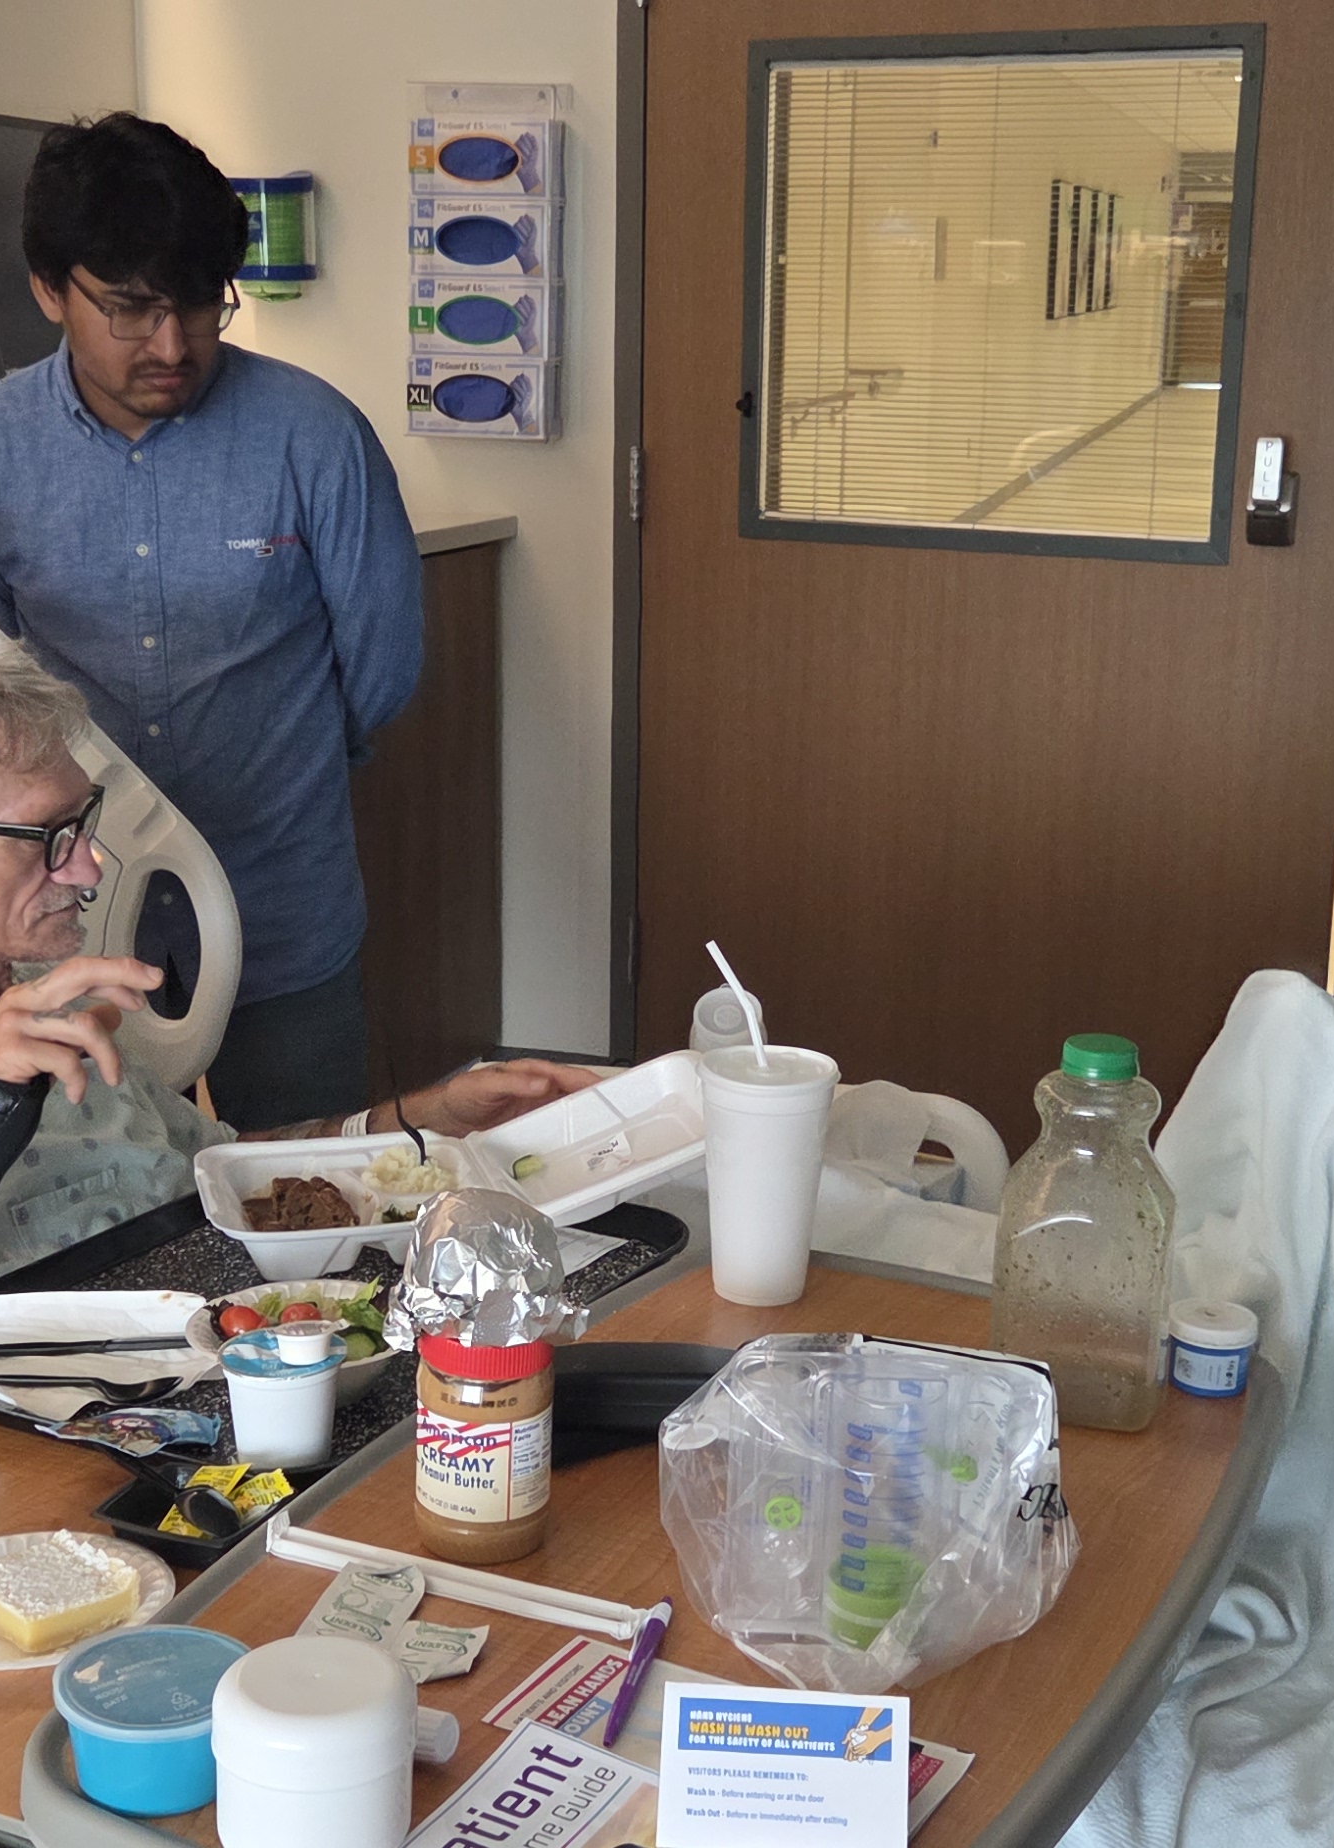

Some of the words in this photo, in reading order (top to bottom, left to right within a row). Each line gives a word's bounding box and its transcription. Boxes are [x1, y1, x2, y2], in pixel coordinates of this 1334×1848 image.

[415, 148, 427, 166] S
[413, 229, 429, 247] M
[417, 308, 428, 326] L
[409, 387, 429, 404] XL
[1262, 441, 1273, 497] PULL
[226, 537, 266, 550] TOMMY
[422, 1417, 497, 1447] American
[422, 1444, 495, 1474] CREAMY
[454, 1472, 495, 1489] Butter
[329, 1616, 377, 1639] POLIDENT
[412, 1640, 462, 1654] POLIDENT
[543, 1686, 558, 1700] AND
[555, 1663, 584, 1688] VISITORS
[540, 1696, 584, 1727] LEAN
[573, 1658, 624, 1697] HANDS
[564, 1700, 606, 1735] OUNT
[690, 1710, 714, 1720] HAND
[689, 1722, 724, 1734] WASH
[728, 1724, 741, 1735] IN
[745, 1725, 780, 1737] WASH
[784, 1727, 809, 1739] OUT
[689, 1734, 706, 1744] FOR
[709, 1735, 725, 1745] THE
[727, 1736, 759, 1748] SAFETY
[761, 1738, 772, 1748] OF
[775, 1739, 790, 1749] ALL
[792, 1740, 835, 1752] PATIENTS
[688, 1766, 721, 1776] VISITORS
[723, 1769, 751, 1778] PLEASE
[753, 1771, 795, 1780] REMEMBER
[796, 1772, 809, 1781] TO:
[441, 1744, 584, 1848] tient
[551, 1766, 617, 1822] Guide
[687, 1787, 707, 1796] Wash
[708, 1788, 715, 1797] In
[722, 1789, 744, 1798] Before
[745, 1791, 775, 1802] entering
[795, 1793, 806, 1802] the
[808, 1794, 824, 1803] door
[686, 1808, 706, 1816] Wash
[708, 1808, 720, 1817] Out
[726, 1810, 749, 1819] Before
[805, 1814, 822, 1823] after
[823, 1815, 848, 1827] exiting
